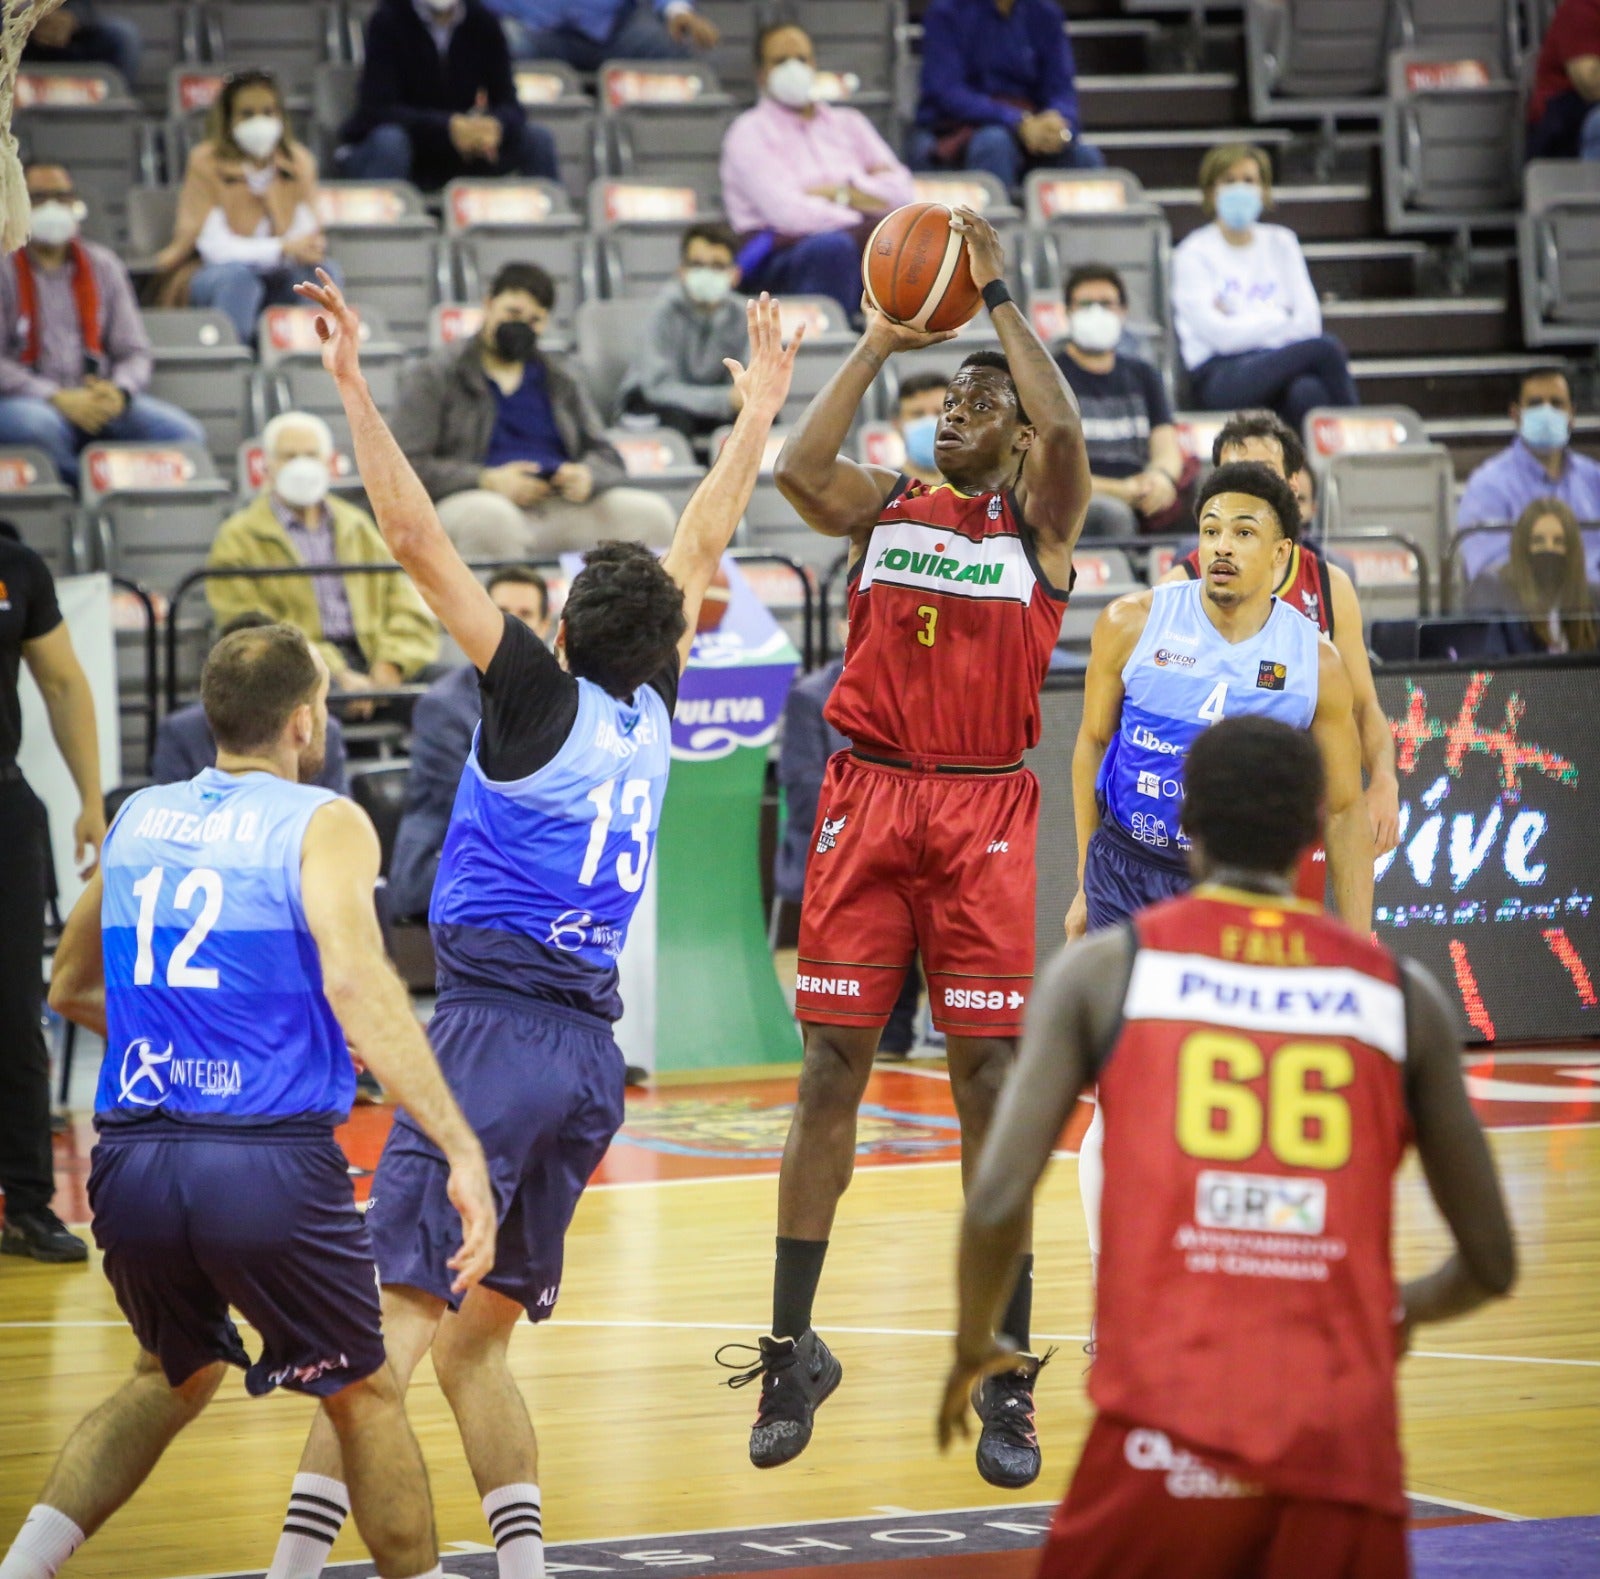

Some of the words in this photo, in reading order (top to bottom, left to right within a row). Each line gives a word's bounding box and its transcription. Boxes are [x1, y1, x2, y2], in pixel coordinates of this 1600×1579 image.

[916, 605, 938, 647] 3
[1197, 682, 1229, 728] 4
[577, 778, 652, 893] 13
[132, 866, 224, 989] 12
[1219, 925, 1316, 967] FALL
[796, 973, 861, 997] BERNER
[1179, 972, 1361, 1016] PULEVA
[169, 1058, 242, 1089] INTEGRA
[1174, 1030, 1355, 1171] 66
